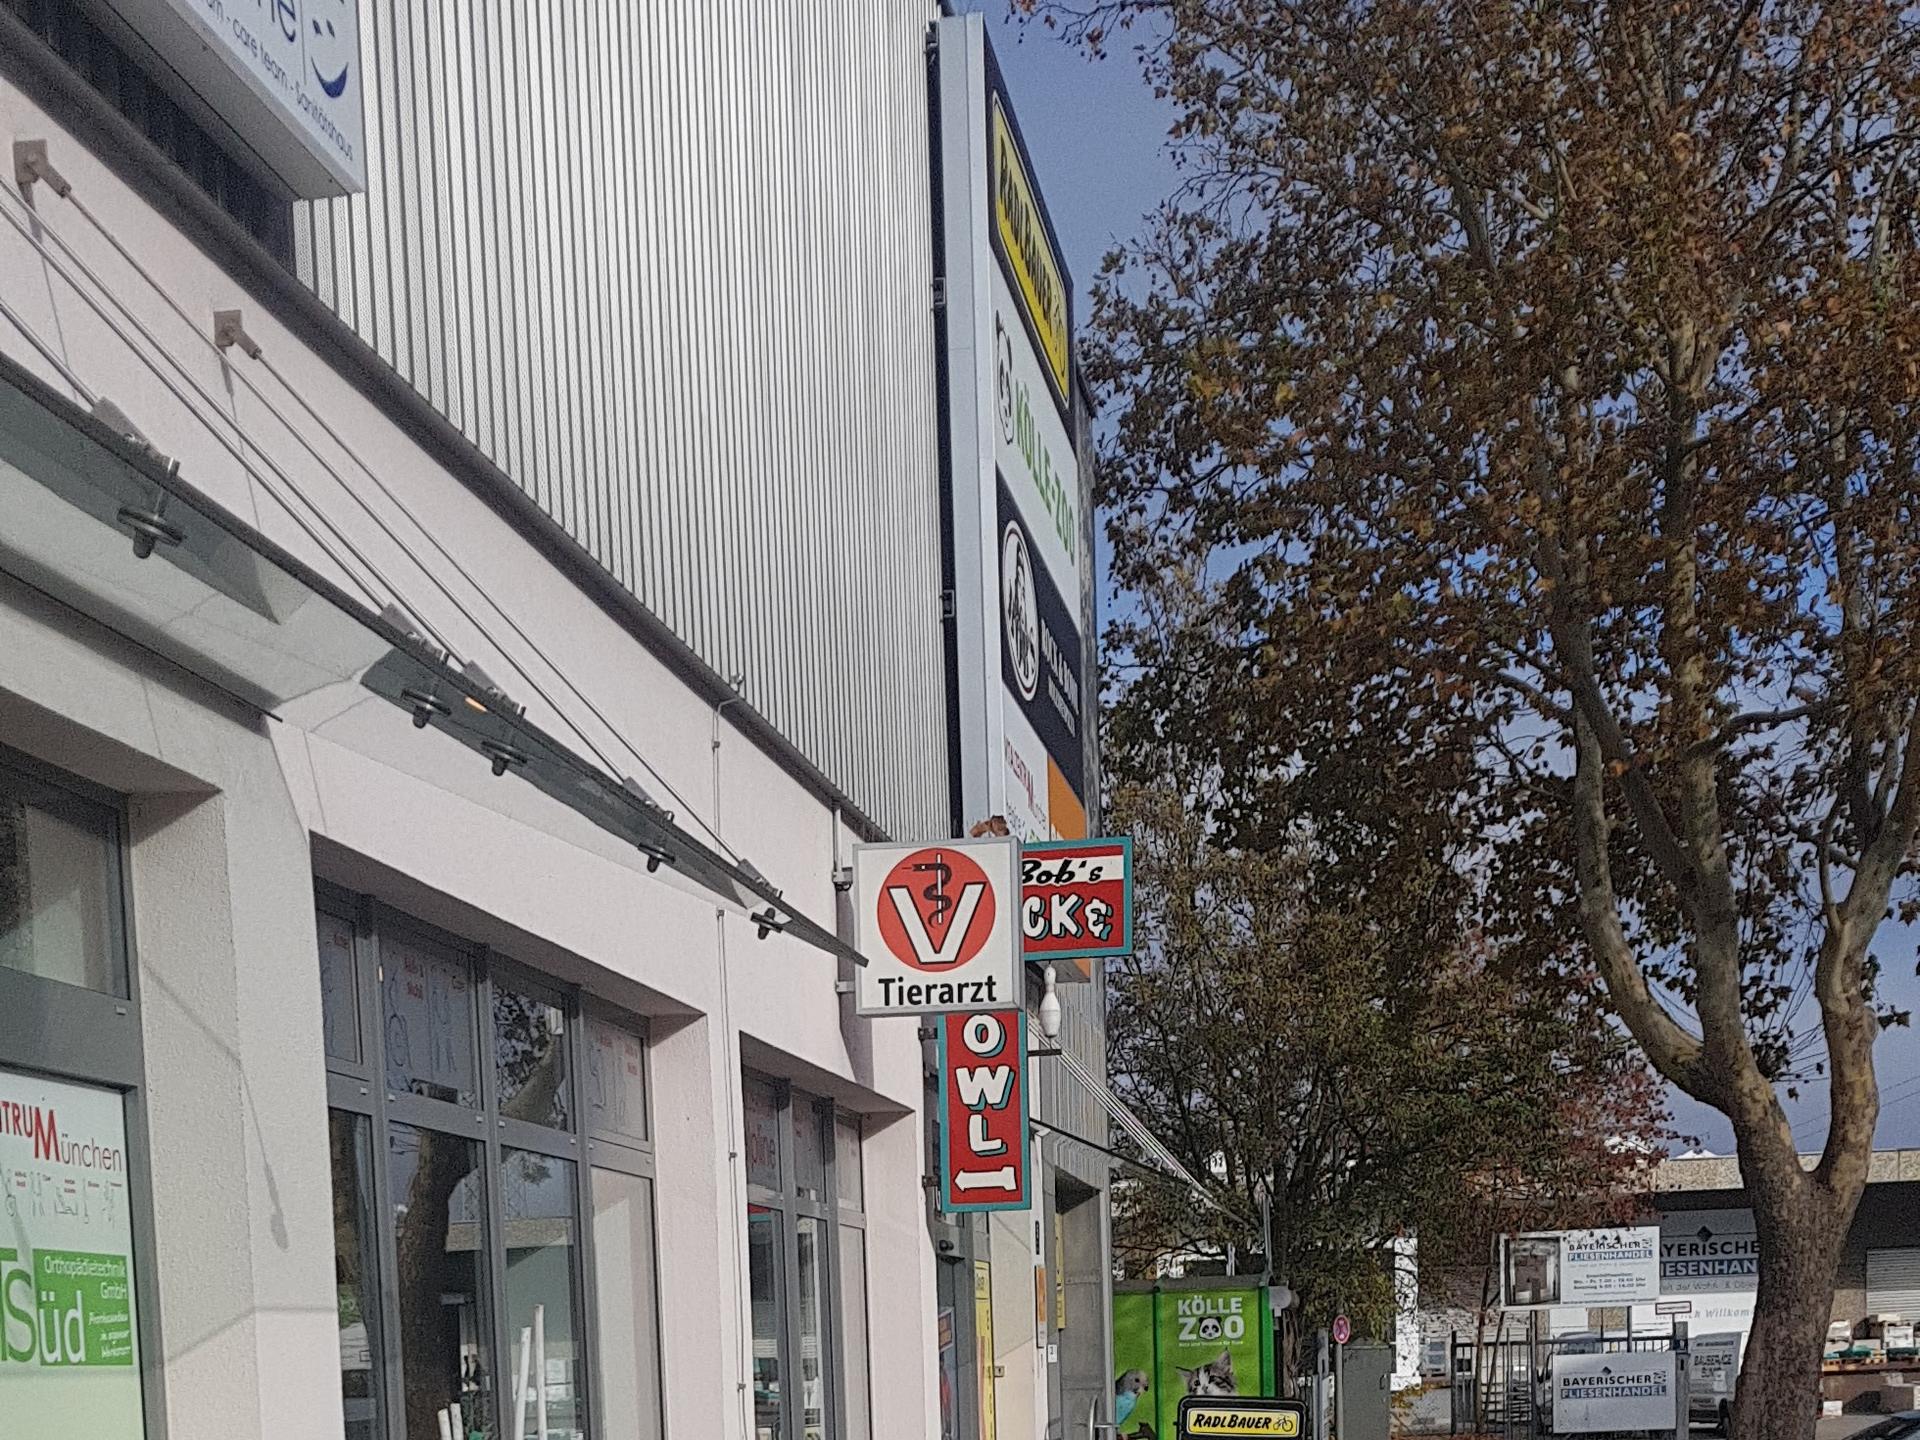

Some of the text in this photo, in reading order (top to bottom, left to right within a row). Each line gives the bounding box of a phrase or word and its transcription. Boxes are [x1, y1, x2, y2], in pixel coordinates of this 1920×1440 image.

[878, 975, 997, 1007] Tierarzt
[1568, 1250, 1653, 1261] FLIESENHANDEL
[1178, 1295, 1243, 1316] KÖLLE
[1562, 1374, 1652, 1387] BAYERISCHER
[1561, 1386, 1666, 1399] FLIESENHANDEL
[1193, 1413, 1272, 1430] RADLBAUER
